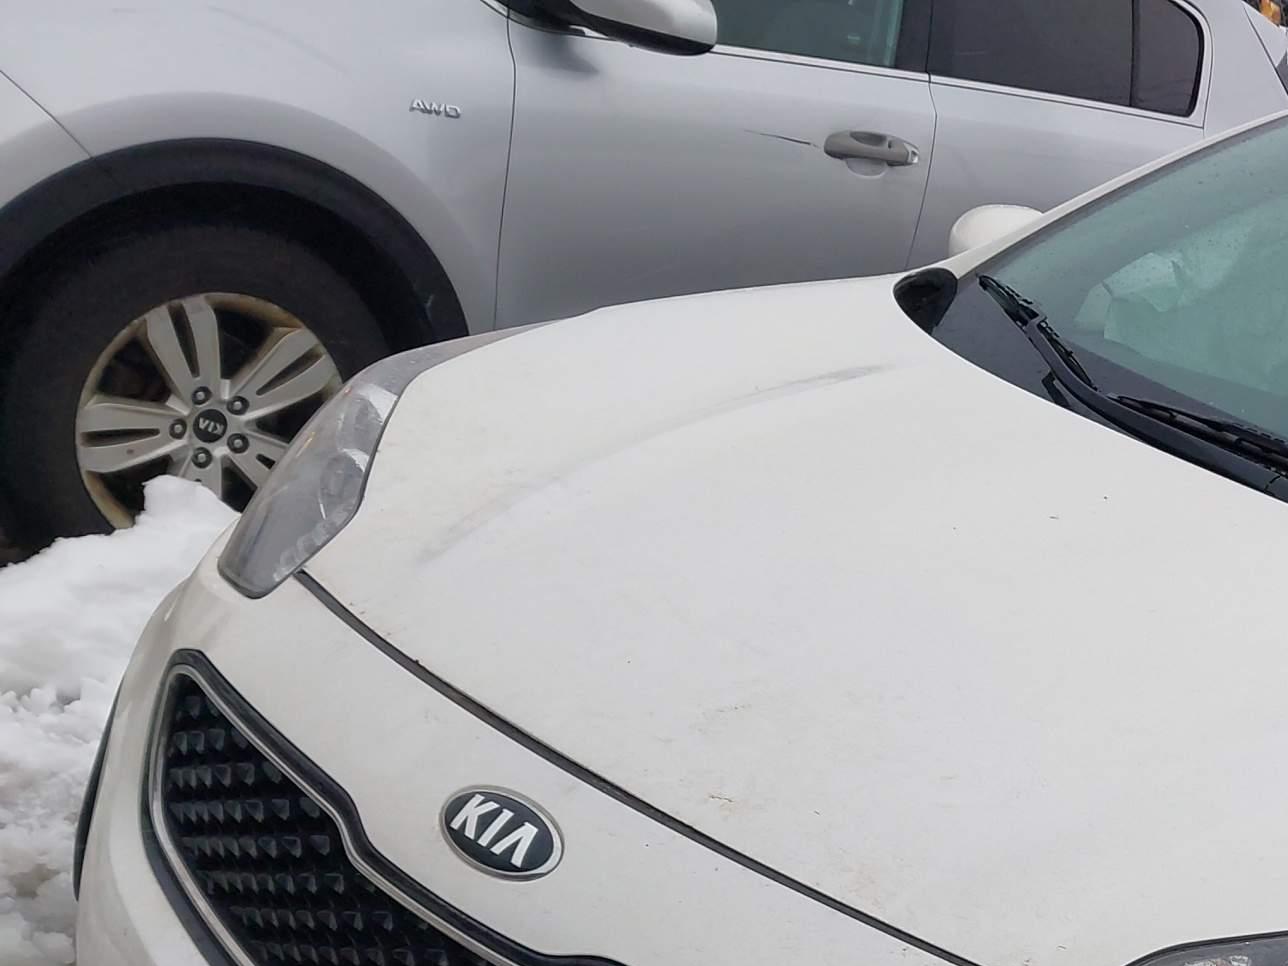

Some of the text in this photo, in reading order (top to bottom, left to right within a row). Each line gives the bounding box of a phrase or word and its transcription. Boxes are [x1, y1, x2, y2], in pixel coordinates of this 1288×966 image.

[409, 98, 461, 119] AWD
[198, 416, 225, 437] KIA
[449, 793, 539, 869] KIA
